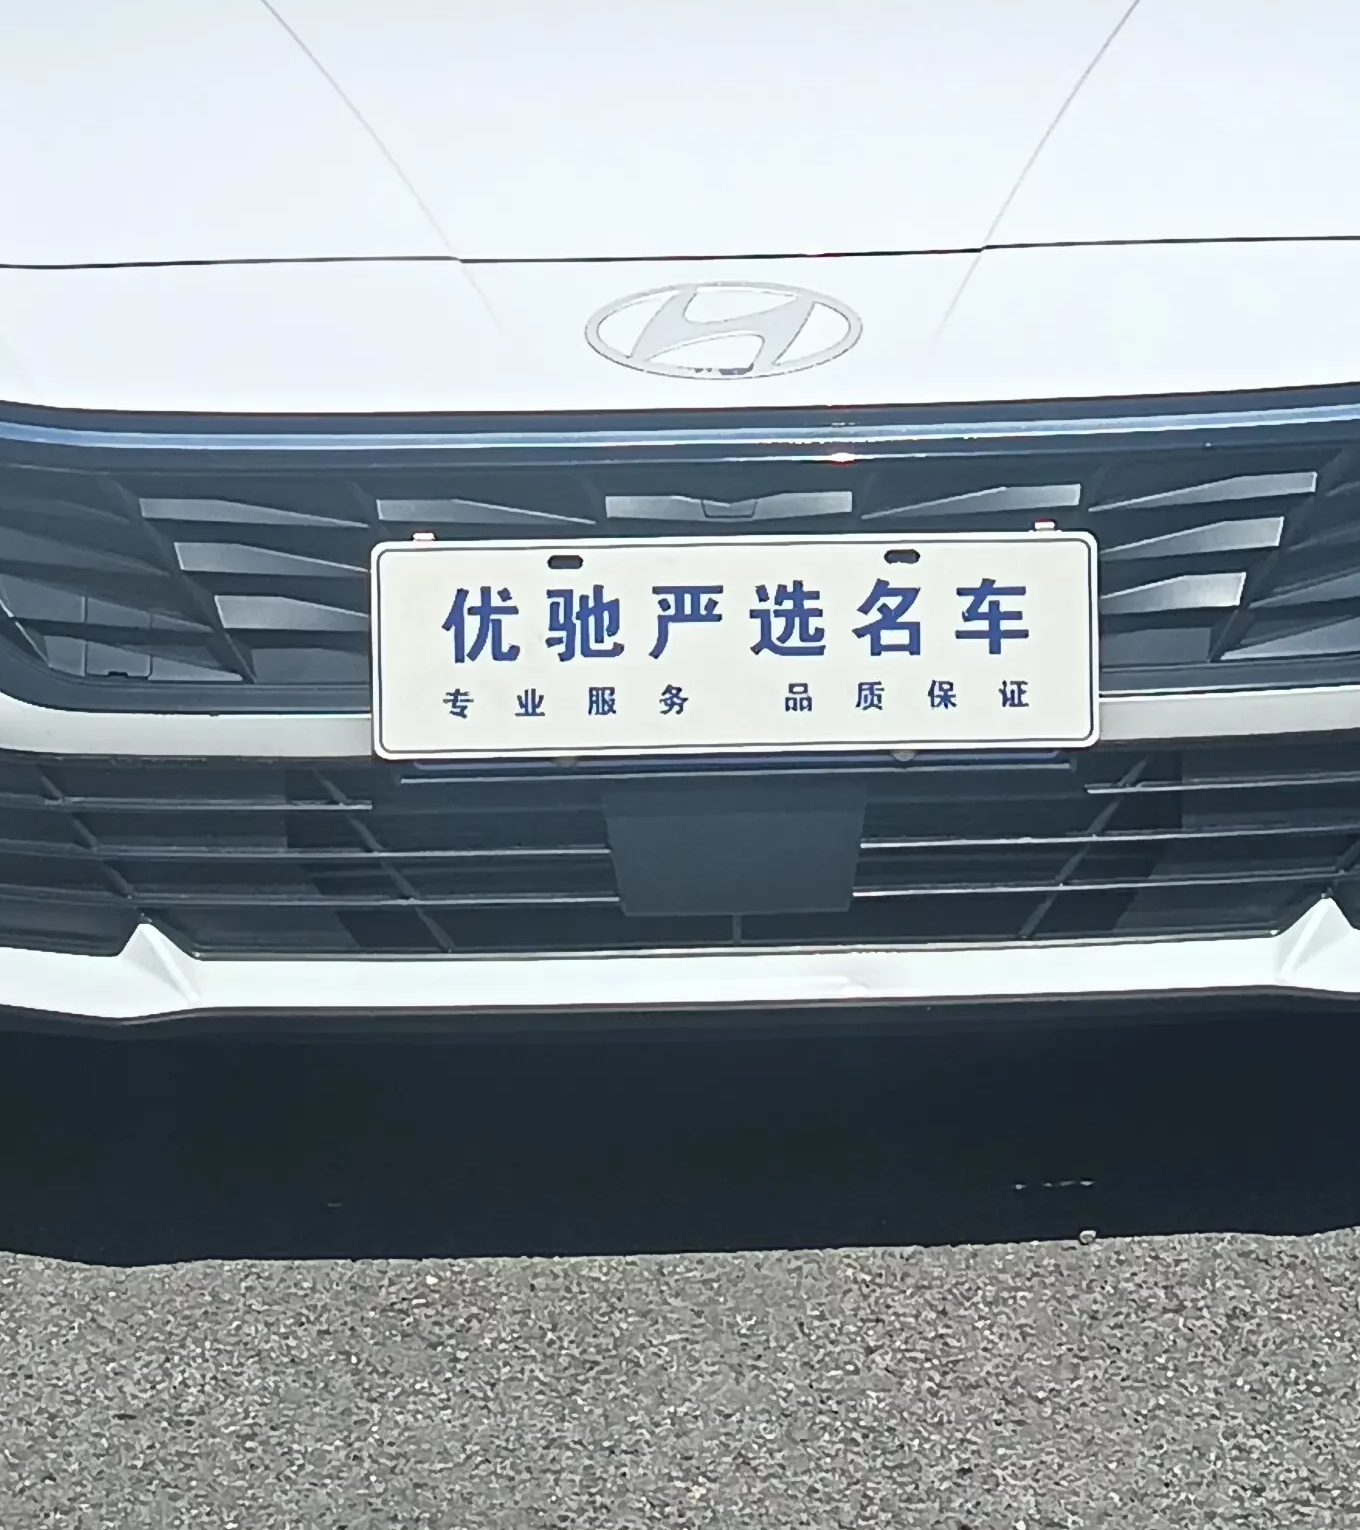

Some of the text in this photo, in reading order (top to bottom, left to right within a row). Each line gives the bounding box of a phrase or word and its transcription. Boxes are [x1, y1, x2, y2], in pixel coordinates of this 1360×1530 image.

[441, 577, 1030, 664] 优驰严选名车
[442, 679, 1030, 719] 专业服务 品质保证
